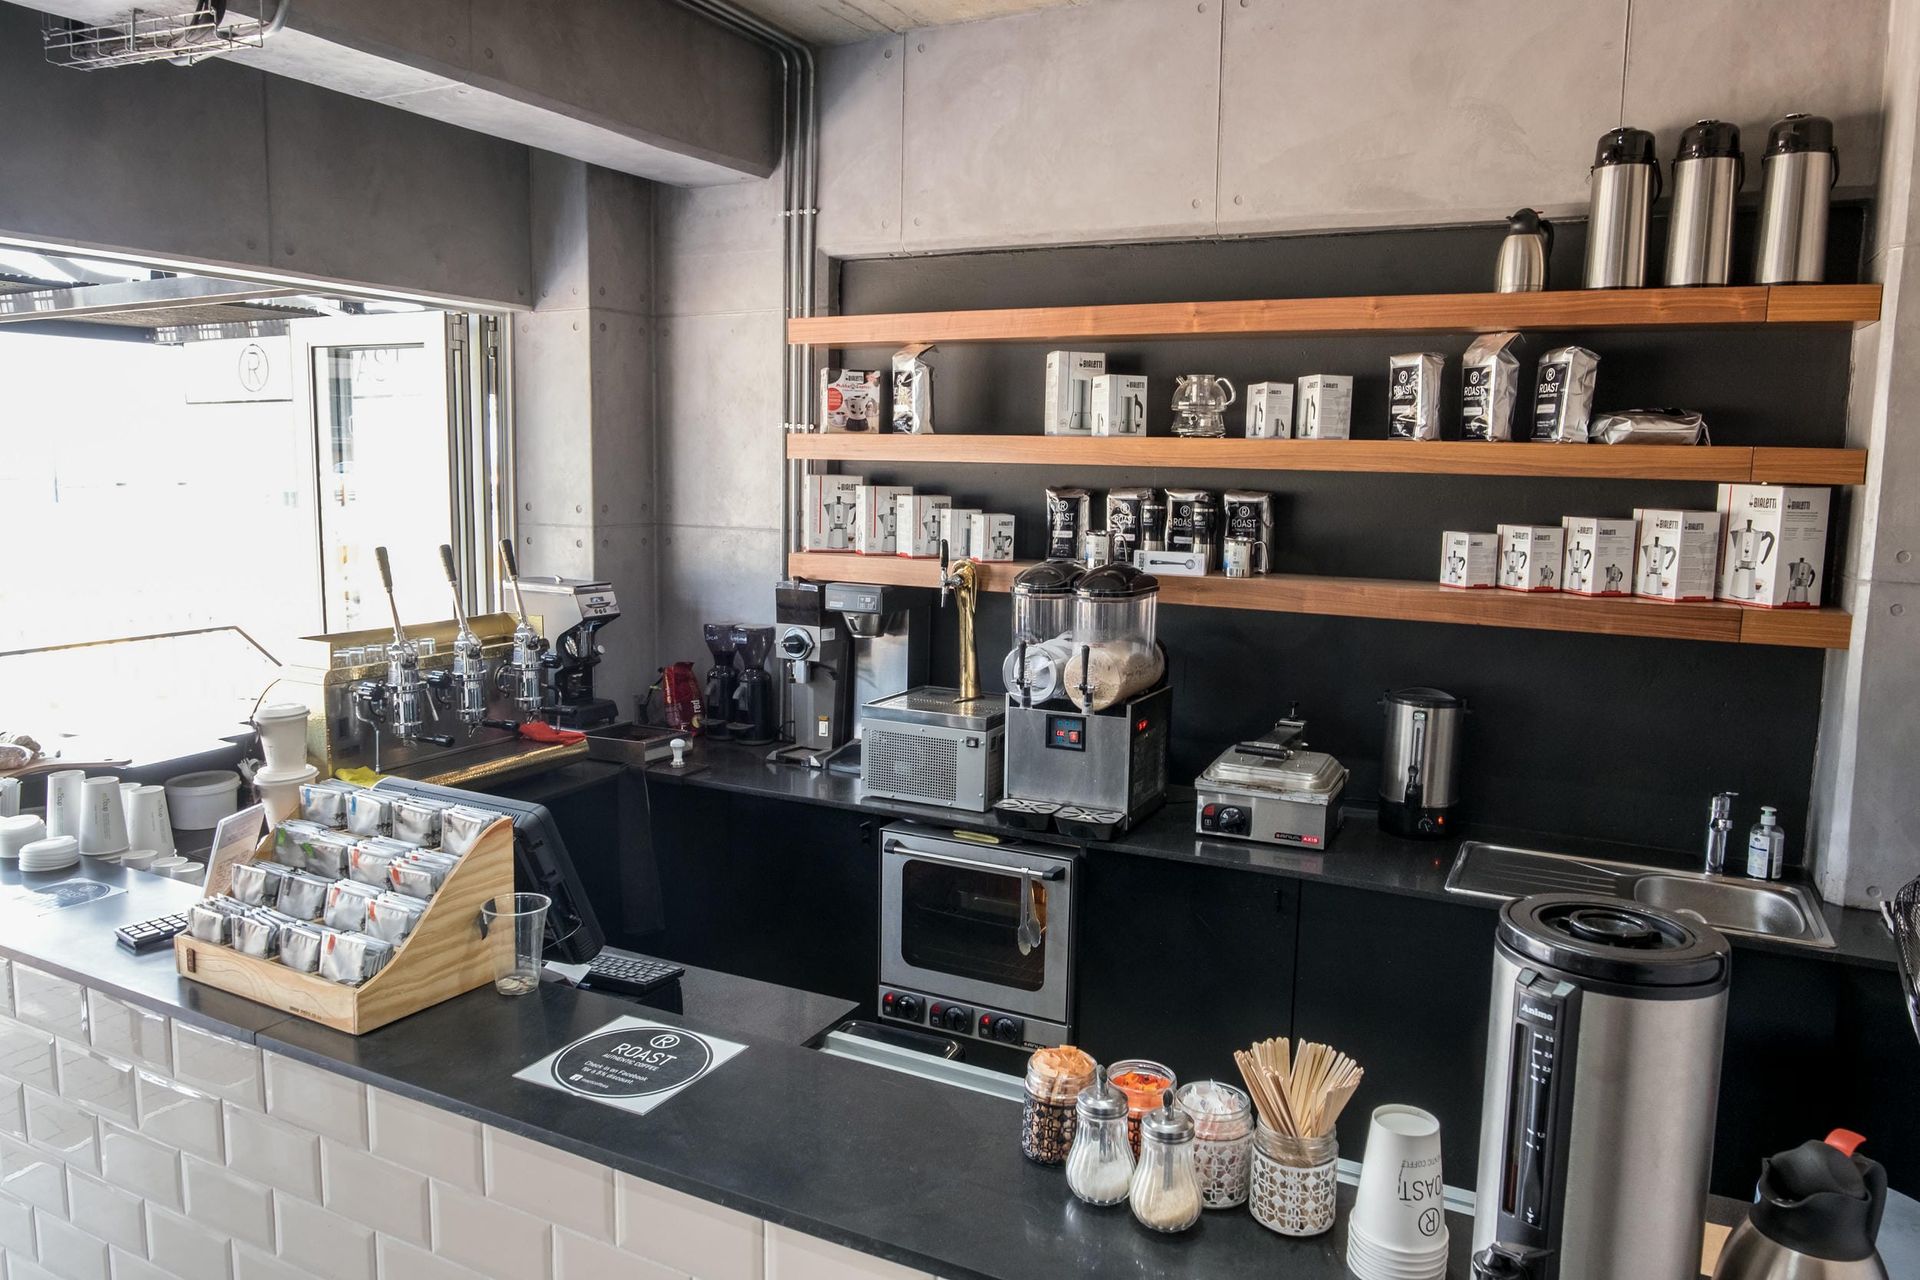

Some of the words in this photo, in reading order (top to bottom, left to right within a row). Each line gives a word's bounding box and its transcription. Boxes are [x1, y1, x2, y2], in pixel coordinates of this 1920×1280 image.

[1539, 382, 1560, 394] ROAST
[1754, 497, 1777, 509] BIALETTI
[1791, 500, 1811, 510] BIALETTI
[1173, 518, 1192, 527] ROAS
[1231, 519, 1256, 528] ROAST
[1660, 519, 1679, 529] BIALETTI
[1521, 1002, 1554, 1021] Animo
[611, 1042, 677, 1066] ROAST
[584, 1060, 604, 1069] Check
[618, 1070, 649, 1082] Facebook
[1399, 1174, 1442, 1201] OAST
